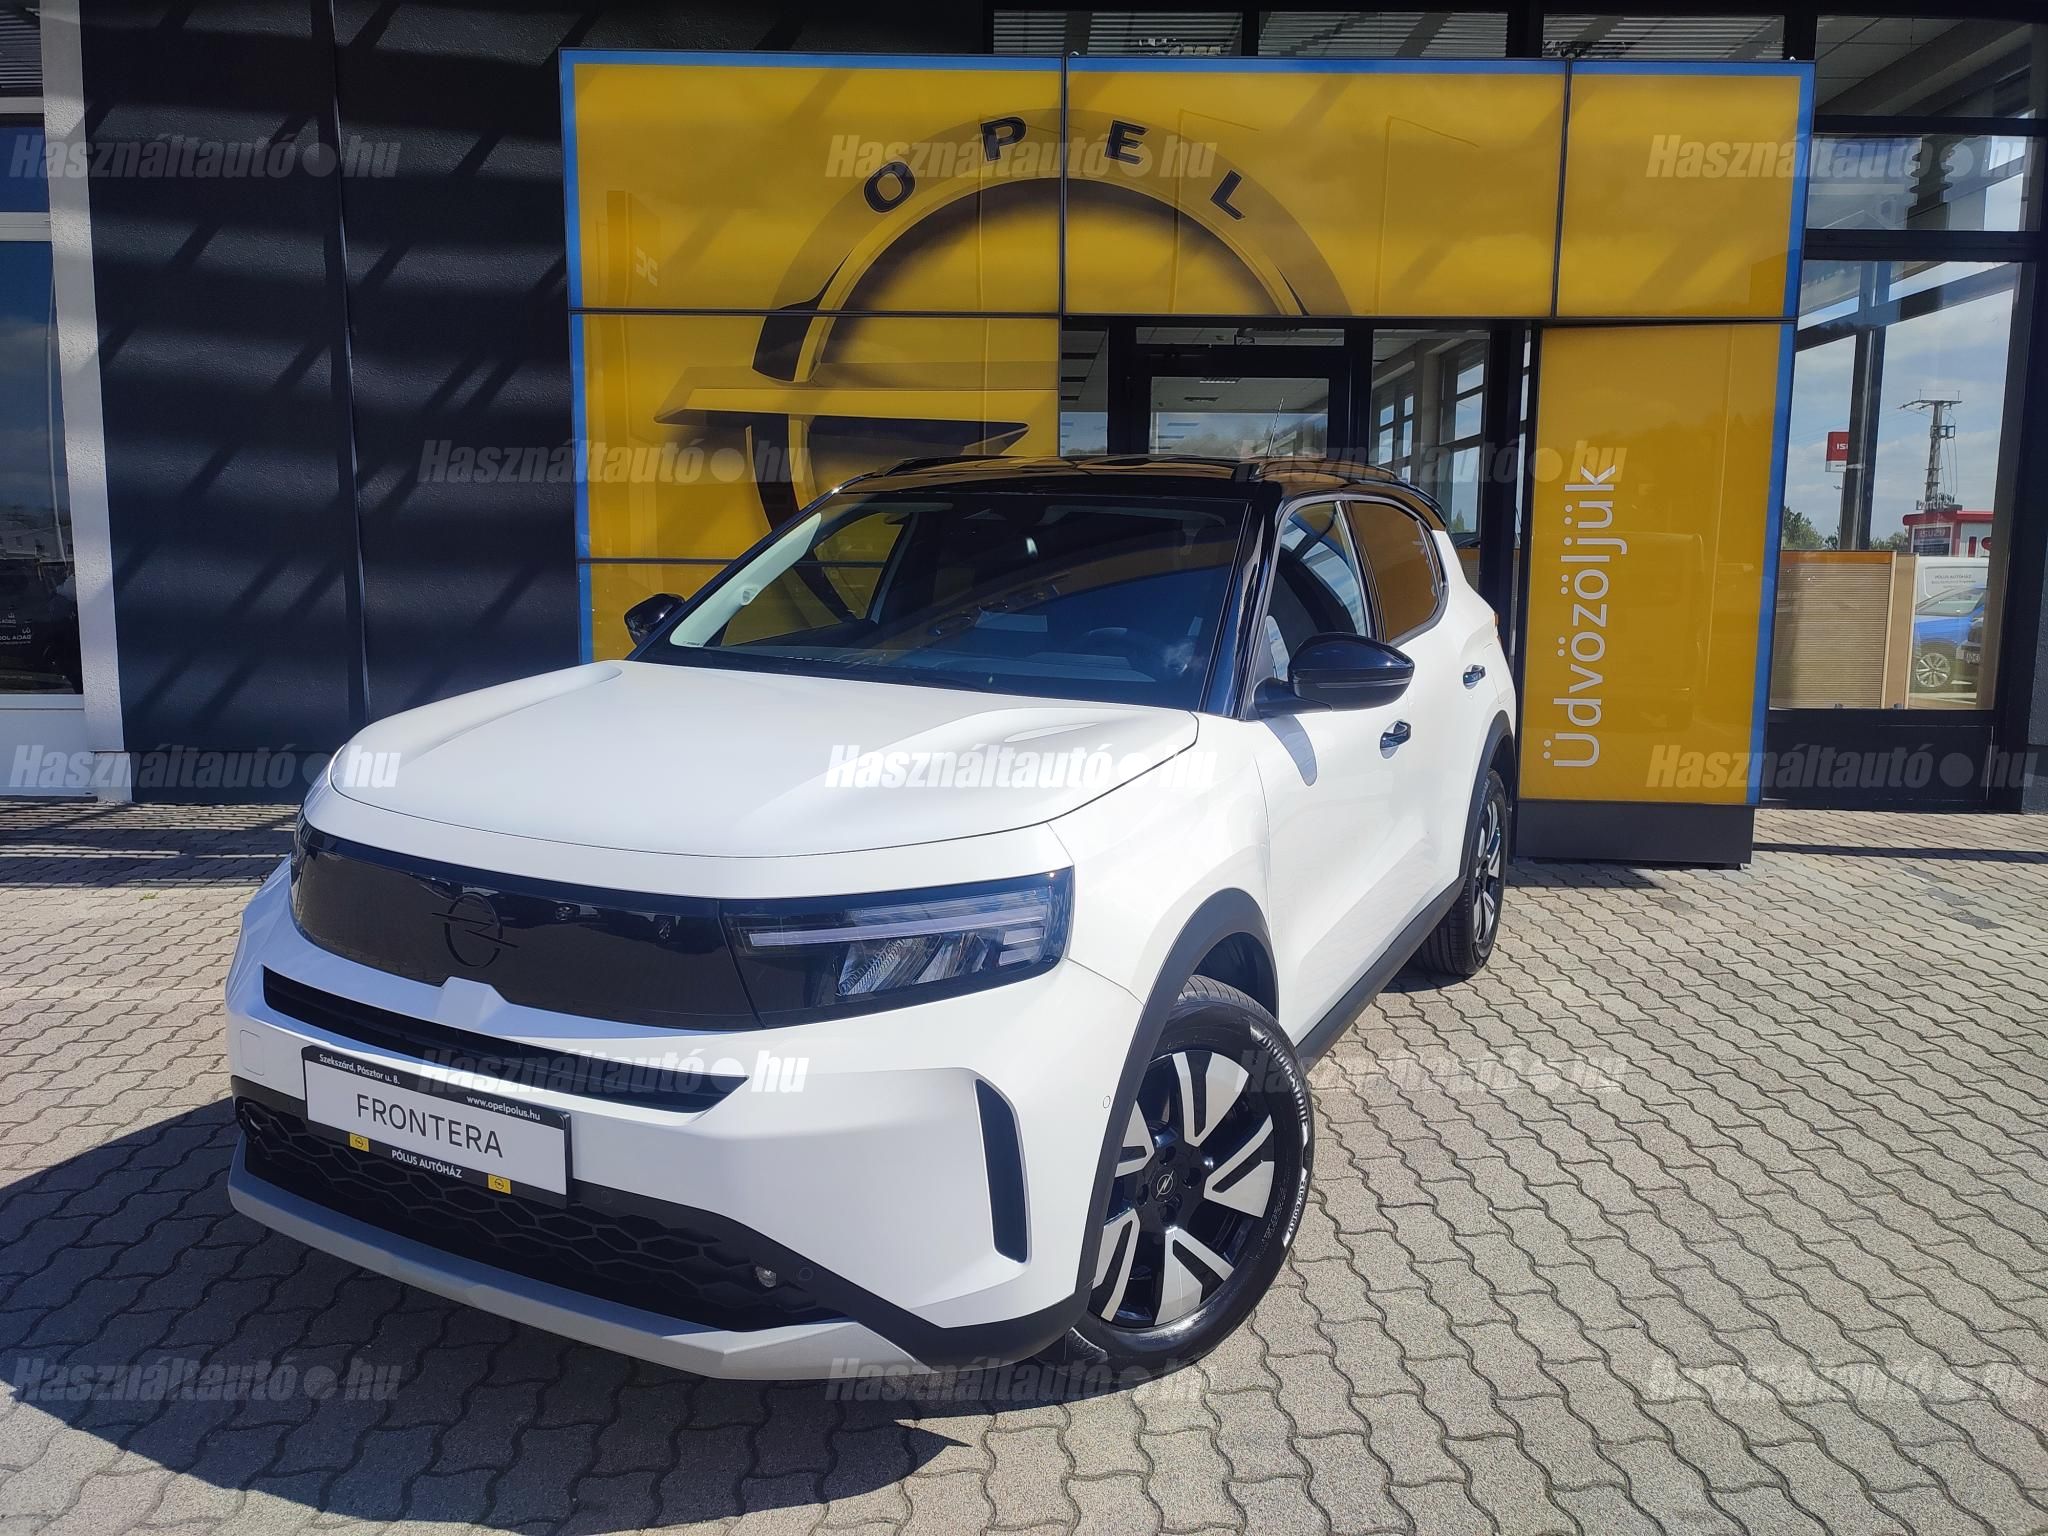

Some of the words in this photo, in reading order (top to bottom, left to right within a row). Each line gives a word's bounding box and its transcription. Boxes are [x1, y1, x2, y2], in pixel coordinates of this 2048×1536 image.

[863, 116, 1246, 221] OPEL
[1542, 464, 1628, 768] Üdvözöljük
[319, 1053, 356, 1073] Szekszárd,
[357, 1064, 384, 1080] Pásztor
[384, 1073, 392, 1082] u.
[356, 1093, 503, 1158] FRONTERA
[467, 1095, 541, 1121] www.opelpolus.hu
[391, 1149, 418, 1166] PÓLUS
[419, 1157, 462, 1178] AUTÓHÁZ
